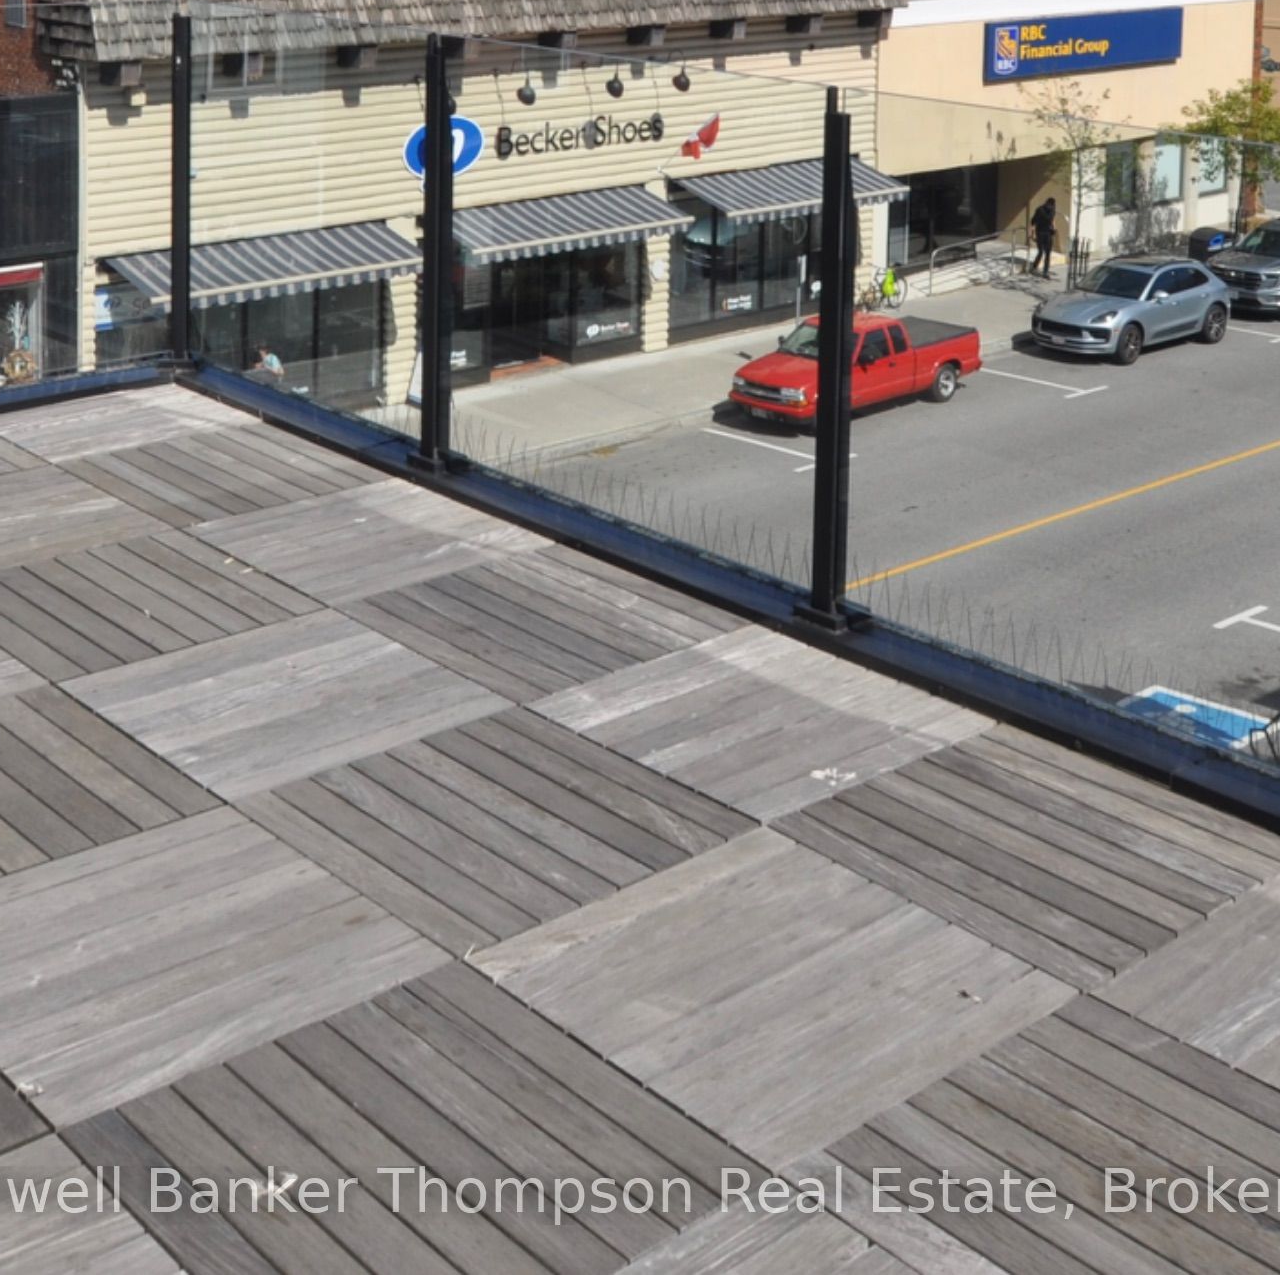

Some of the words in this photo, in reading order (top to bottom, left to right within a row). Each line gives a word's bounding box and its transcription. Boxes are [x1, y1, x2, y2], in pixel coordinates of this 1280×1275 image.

[1020, 24, 1047, 42] RBC
[1020, 37, 1072, 60] Financial
[1075, 37, 1109, 57] Group
[997, 59, 1016, 71] RBC
[496, 122, 586, 158] Becker
[592, 114, 664, 146] Shoes
